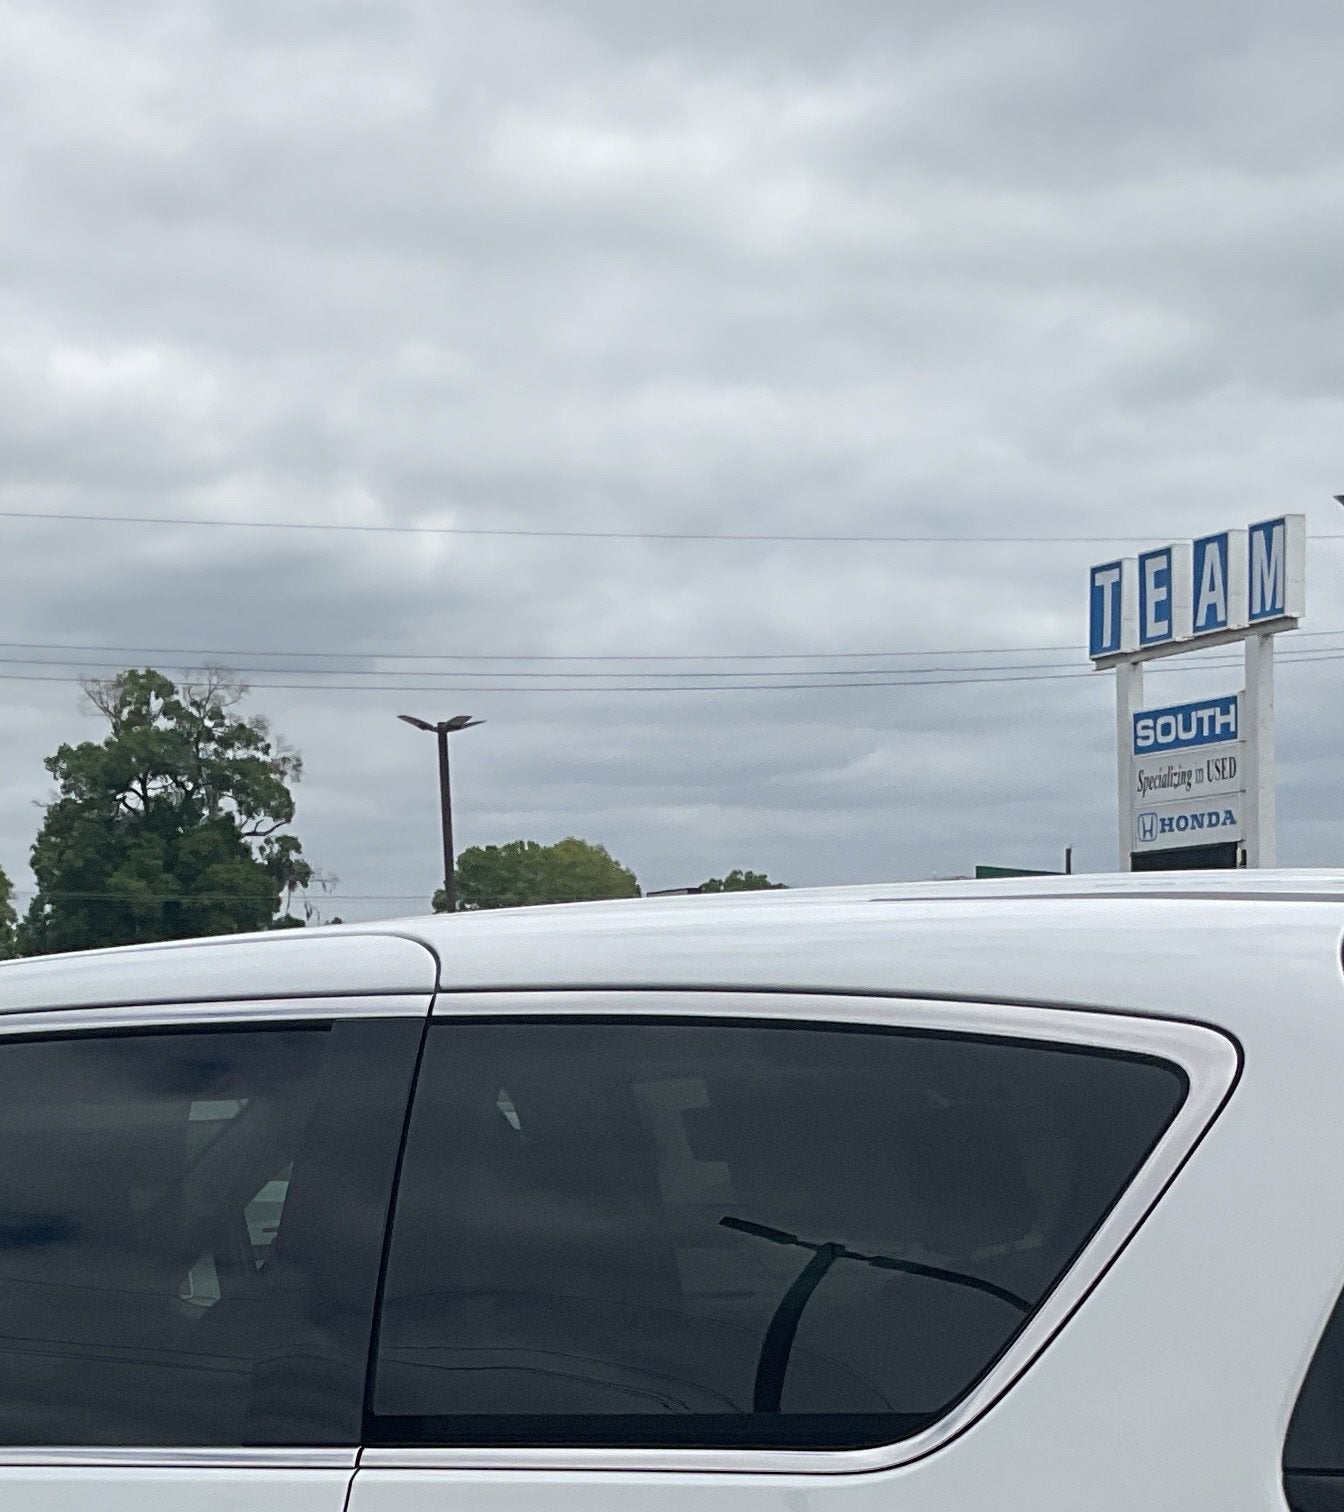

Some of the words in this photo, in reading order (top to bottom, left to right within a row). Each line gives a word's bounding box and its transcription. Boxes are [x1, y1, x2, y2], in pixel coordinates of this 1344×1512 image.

[1094, 525, 1285, 648] TEAM
[1136, 703, 1236, 747] SOUTH
[1137, 764, 1193, 798] Specializing
[1207, 756, 1237, 783] USED
[1159, 809, 1238, 833] HONDA
